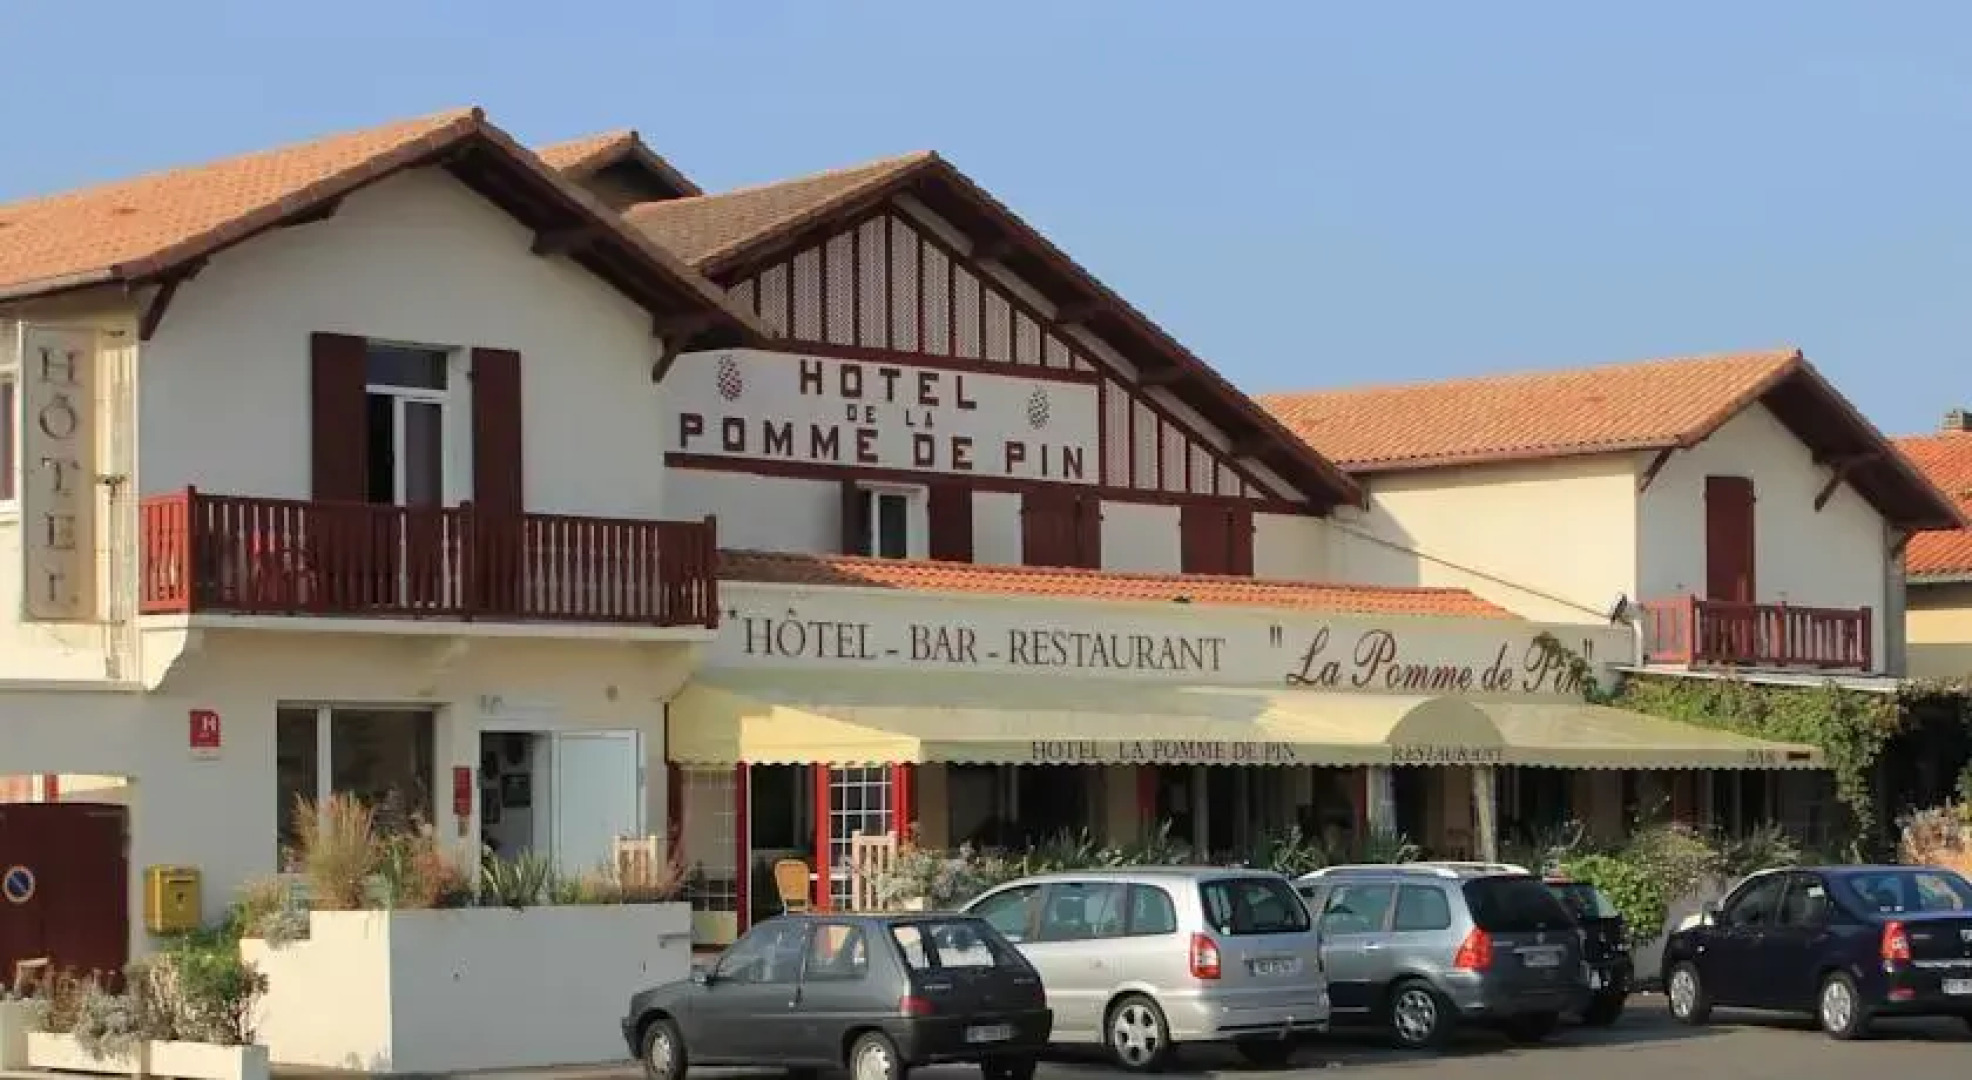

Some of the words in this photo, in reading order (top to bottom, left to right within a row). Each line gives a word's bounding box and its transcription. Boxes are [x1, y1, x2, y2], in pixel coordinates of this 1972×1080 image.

[800, 359, 977, 410] HOTEL
[847, 404, 877, 424] DE
[905, 408, 933, 428] LA
[680, 412, 879, 463] POMME
[914, 433, 974, 470] DE
[1005, 440, 1084, 479] PIN
[742, 606, 878, 659] HÔTEL
[908, 622, 978, 663] BAR
[1009, 629, 1226, 671] RESTAURANT
[1351, 628, 1472, 689] Pomme
[1480, 640, 1513, 692] de
[1032, 741, 1100, 760] HOTEL
[1119, 742, 1144, 760] LA
[1153, 742, 1227, 760] POMME
[1234, 742, 1258, 760] DE
[1265, 743, 1297, 761] PIN
